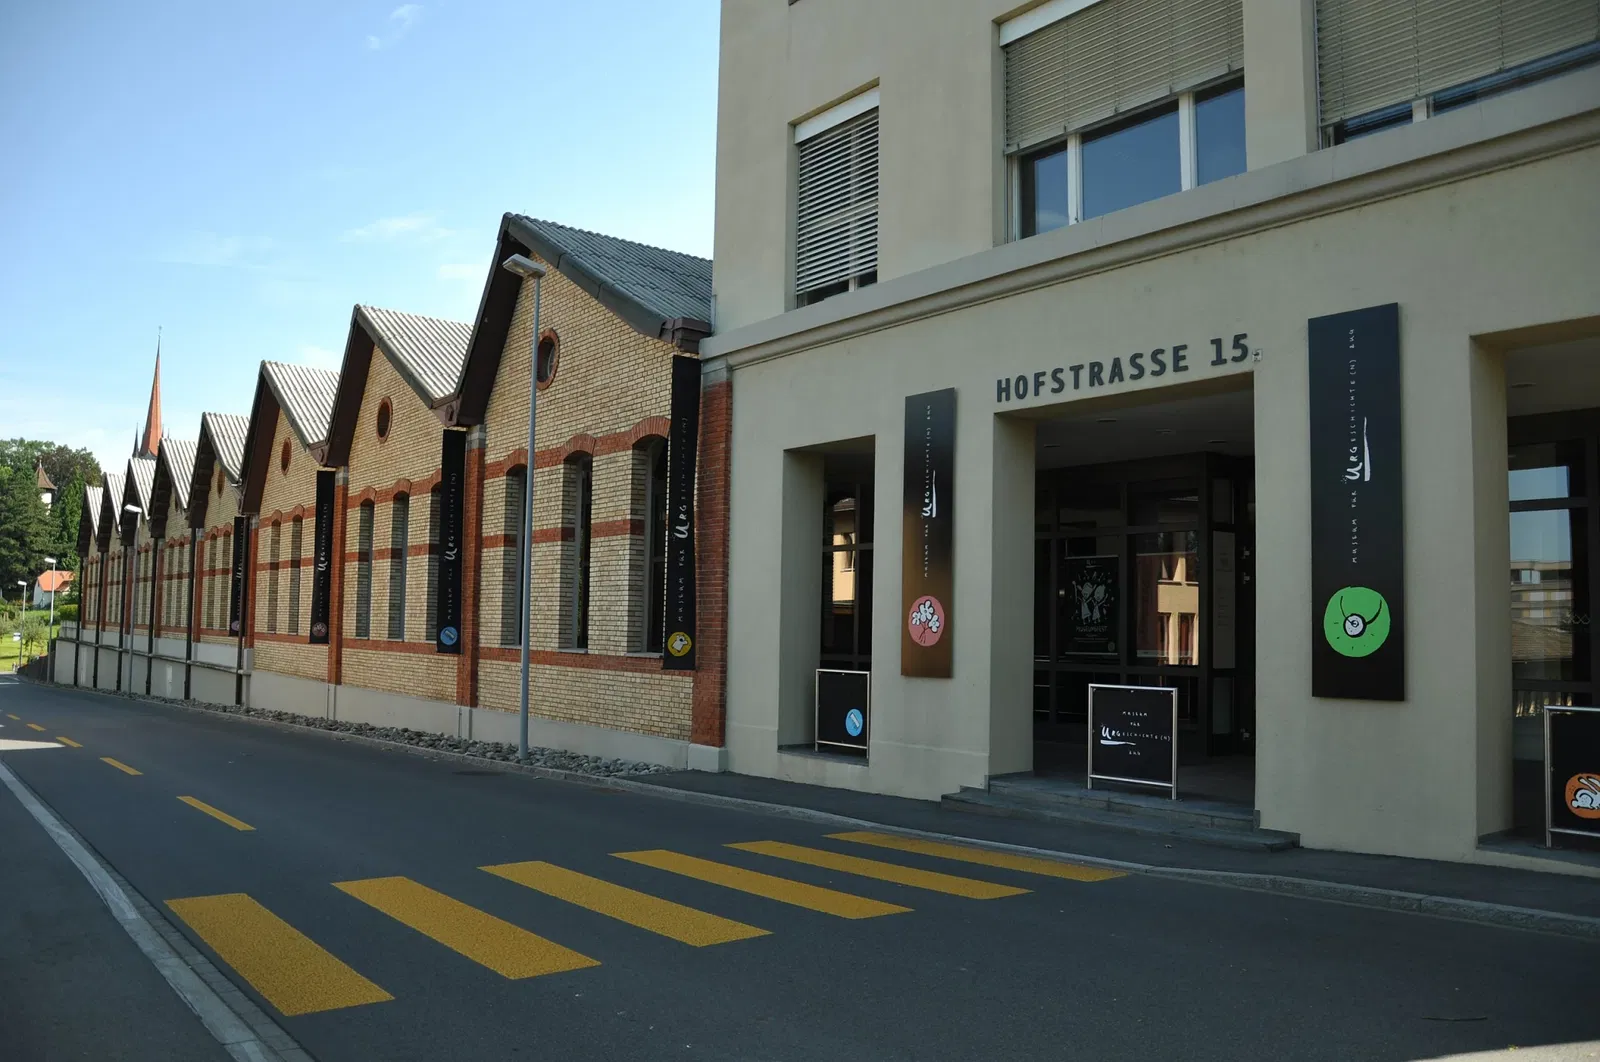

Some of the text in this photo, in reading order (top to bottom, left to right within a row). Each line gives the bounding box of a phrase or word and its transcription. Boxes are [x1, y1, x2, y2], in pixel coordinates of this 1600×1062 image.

[996, 333, 1249, 402] HOFSTRASSE 15
[1350, 518, 1358, 564] MUSEUM
[676, 576, 685, 623] MUSEUM
